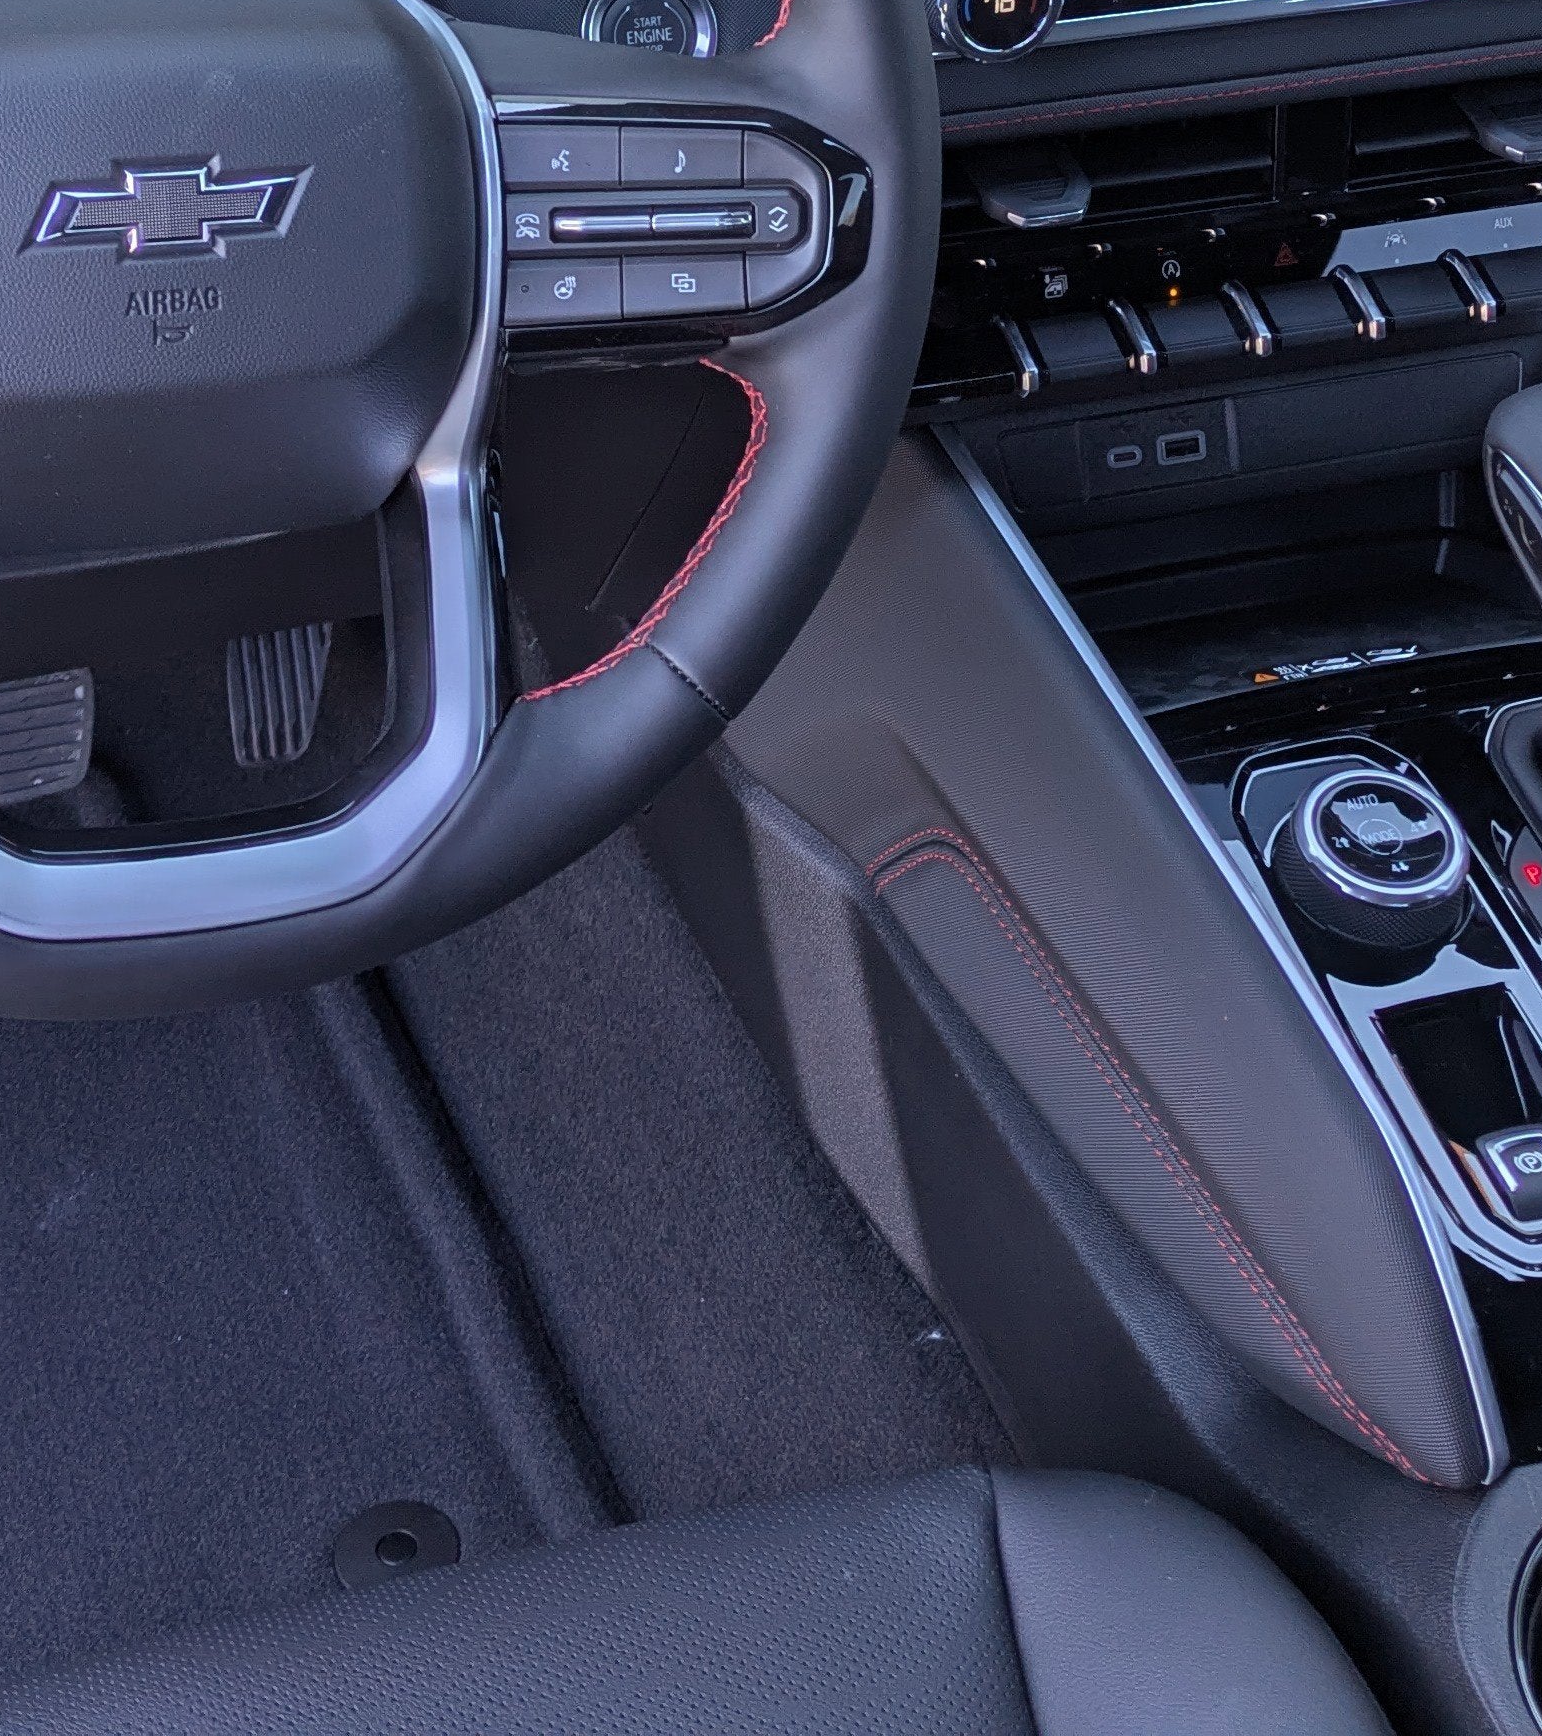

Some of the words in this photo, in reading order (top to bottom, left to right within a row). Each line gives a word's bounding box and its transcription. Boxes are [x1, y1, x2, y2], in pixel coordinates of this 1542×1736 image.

[633, 15, 663, 29] START
[626, 27, 674, 44] ENGINE
[1494, 216, 1514, 230] AUX
[125, 285, 222, 317] AIRBAG
[1346, 793, 1379, 812] AUTO
[1361, 828, 1395, 845] MODE
[1522, 864, 1542, 885] P
